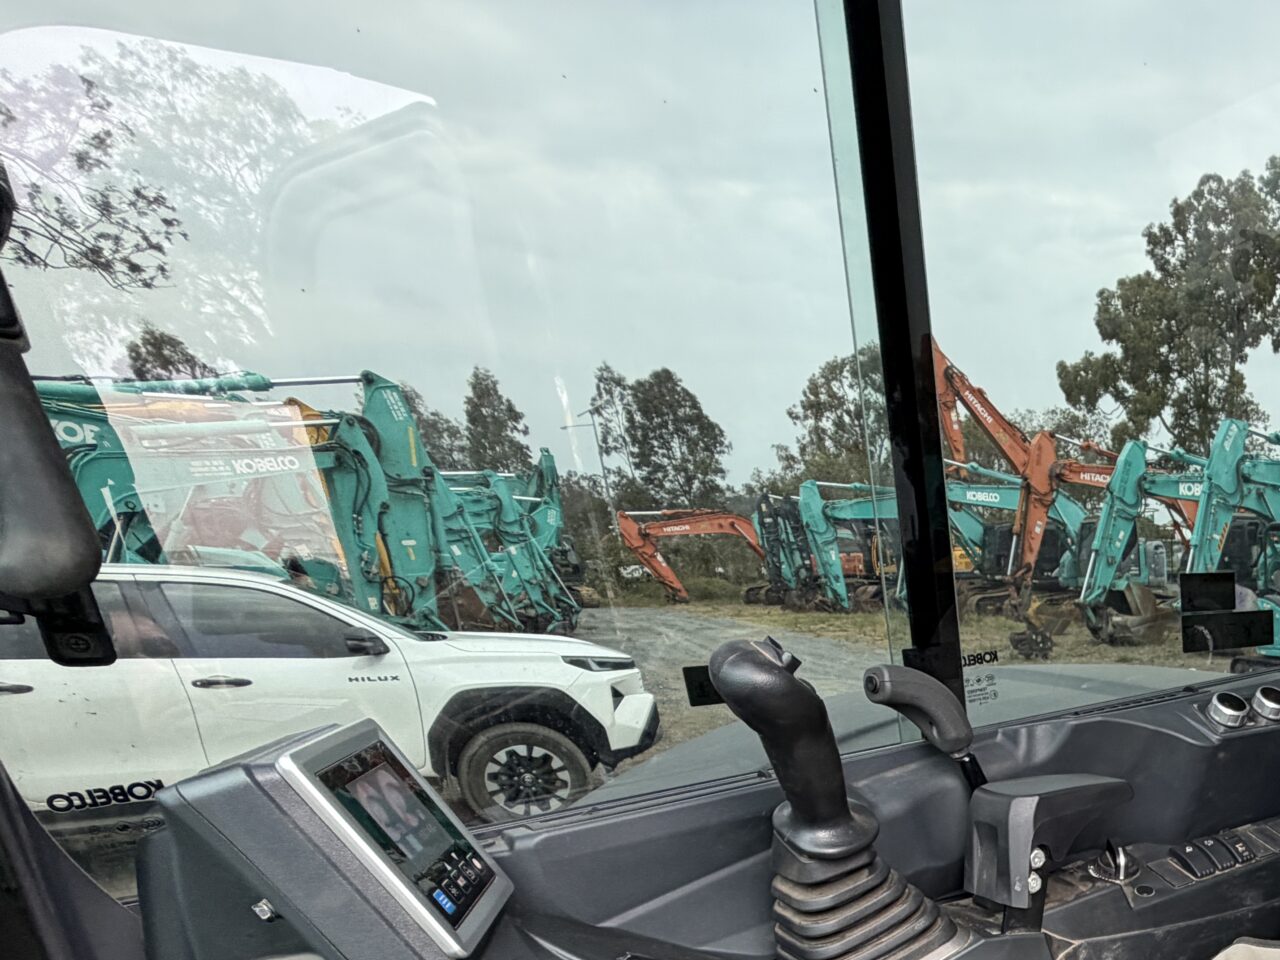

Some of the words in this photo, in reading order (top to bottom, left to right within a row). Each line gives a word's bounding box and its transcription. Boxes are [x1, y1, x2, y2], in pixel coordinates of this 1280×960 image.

[964, 389, 993, 424] HITACHI
[231, 456, 299, 474] KOBELCO
[966, 490, 1000, 503] KOBELCO
[348, 675, 401, 683] HILUX
